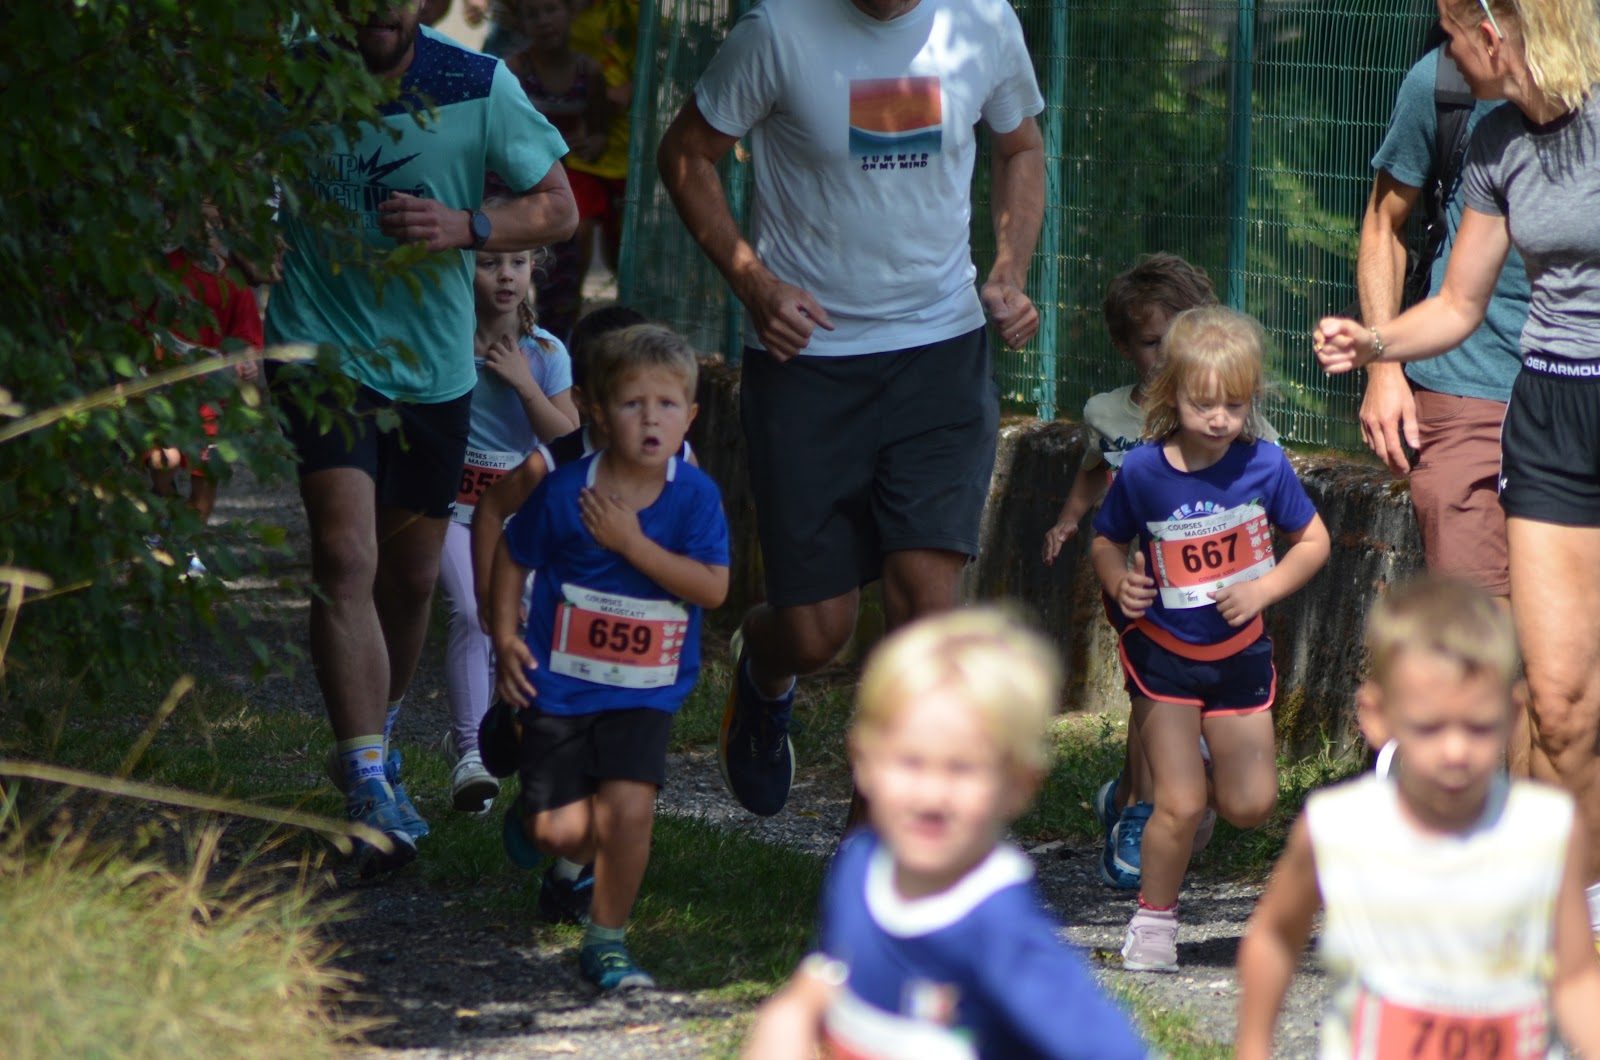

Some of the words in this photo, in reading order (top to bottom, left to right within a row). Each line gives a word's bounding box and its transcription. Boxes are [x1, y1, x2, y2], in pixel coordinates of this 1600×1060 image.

[861, 163, 876, 171] ON
[879, 162, 896, 170] MY
[899, 160, 928, 169] MIND
[467, 458, 507, 469] MAGSTATT
[460, 469, 503, 497] 65
[1167, 522, 1203, 531] COURSES
[1184, 523, 1228, 538] MAGSTATT
[1181, 532, 1239, 574] 667
[600, 605, 647, 618] MAGSTATT
[588, 618, 652, 655] 659
